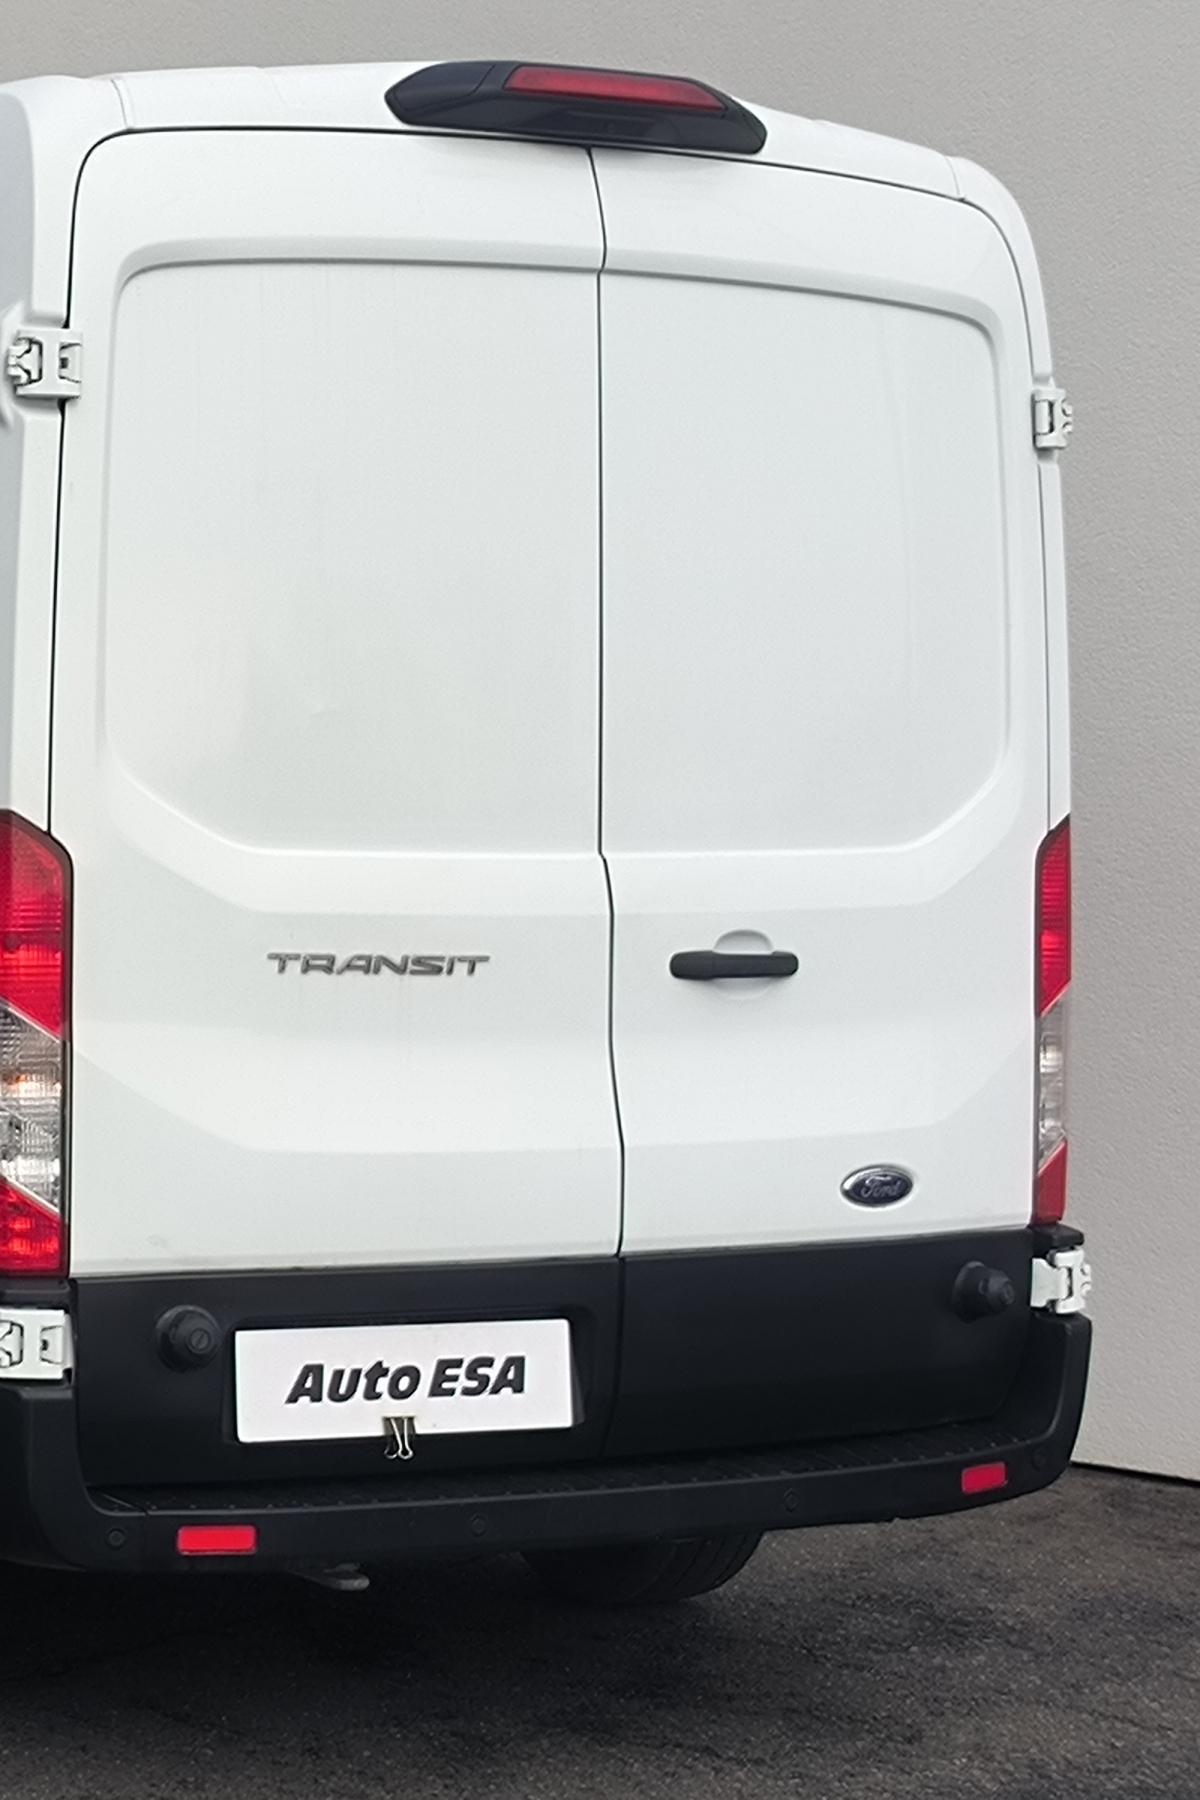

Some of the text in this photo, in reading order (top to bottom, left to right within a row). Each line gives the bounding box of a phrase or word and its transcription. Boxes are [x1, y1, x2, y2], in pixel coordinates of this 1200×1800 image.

[267, 952, 490, 976] TRANSIT
[859, 1174, 902, 1199] Ford
[285, 1355, 526, 1405] Auto ESA
